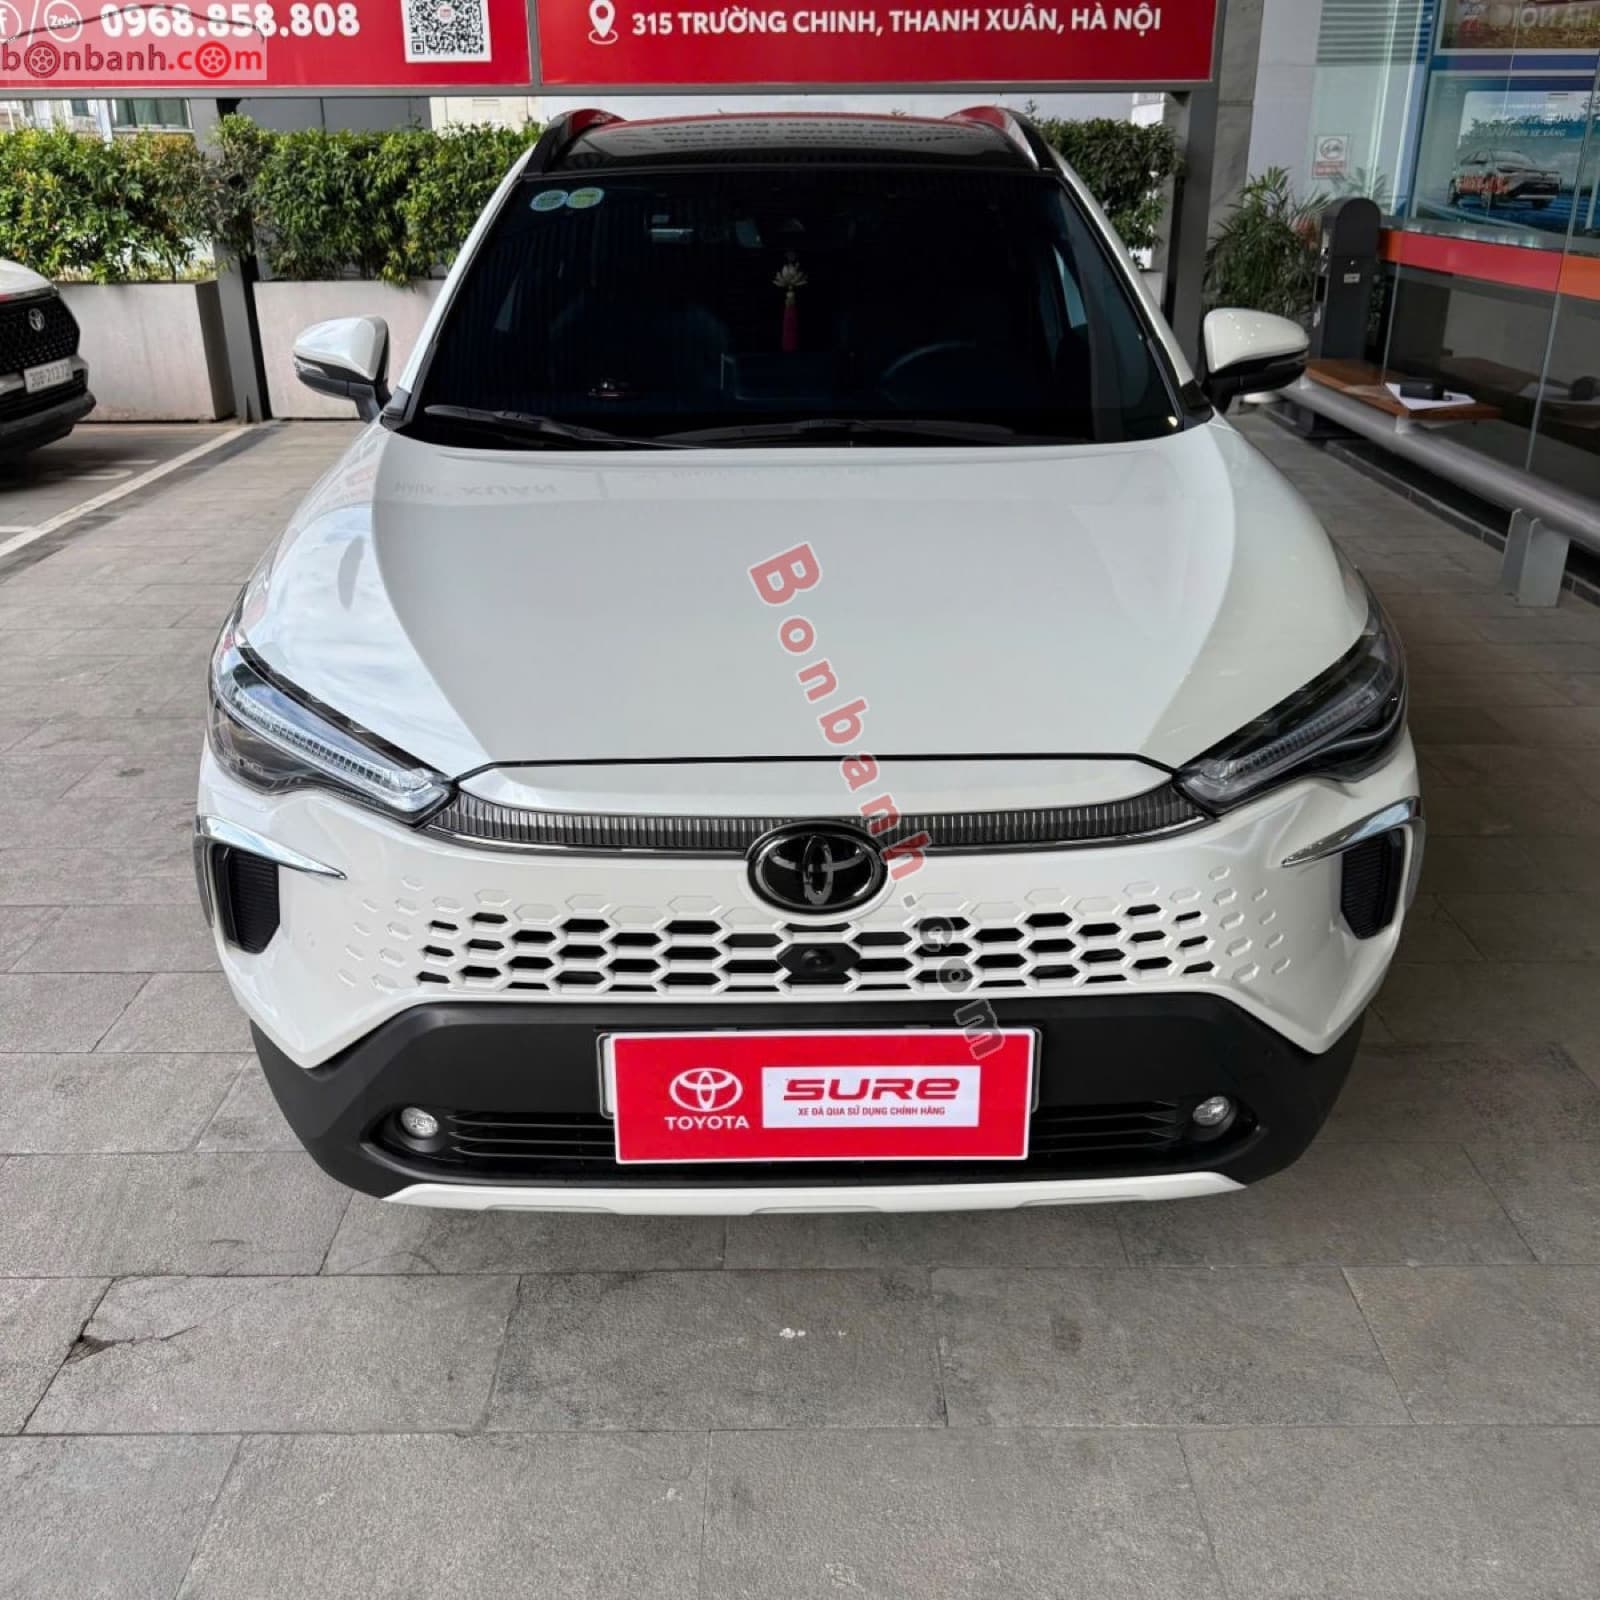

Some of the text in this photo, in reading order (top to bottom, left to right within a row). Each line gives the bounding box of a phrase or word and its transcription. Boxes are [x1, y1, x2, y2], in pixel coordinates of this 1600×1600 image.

[99, 3, 360, 38] 0968.858.808
[631, 2, 1161, 37] 315 TRƯỜNG CHINH, THANH XUÂN, HÀ NỘI
[664, 1115, 751, 1131] TOYOTA
[798, 1106, 809, 1117] XE
[826, 1106, 846, 1117] QUA
[862, 1106, 888, 1118] DỤNG
